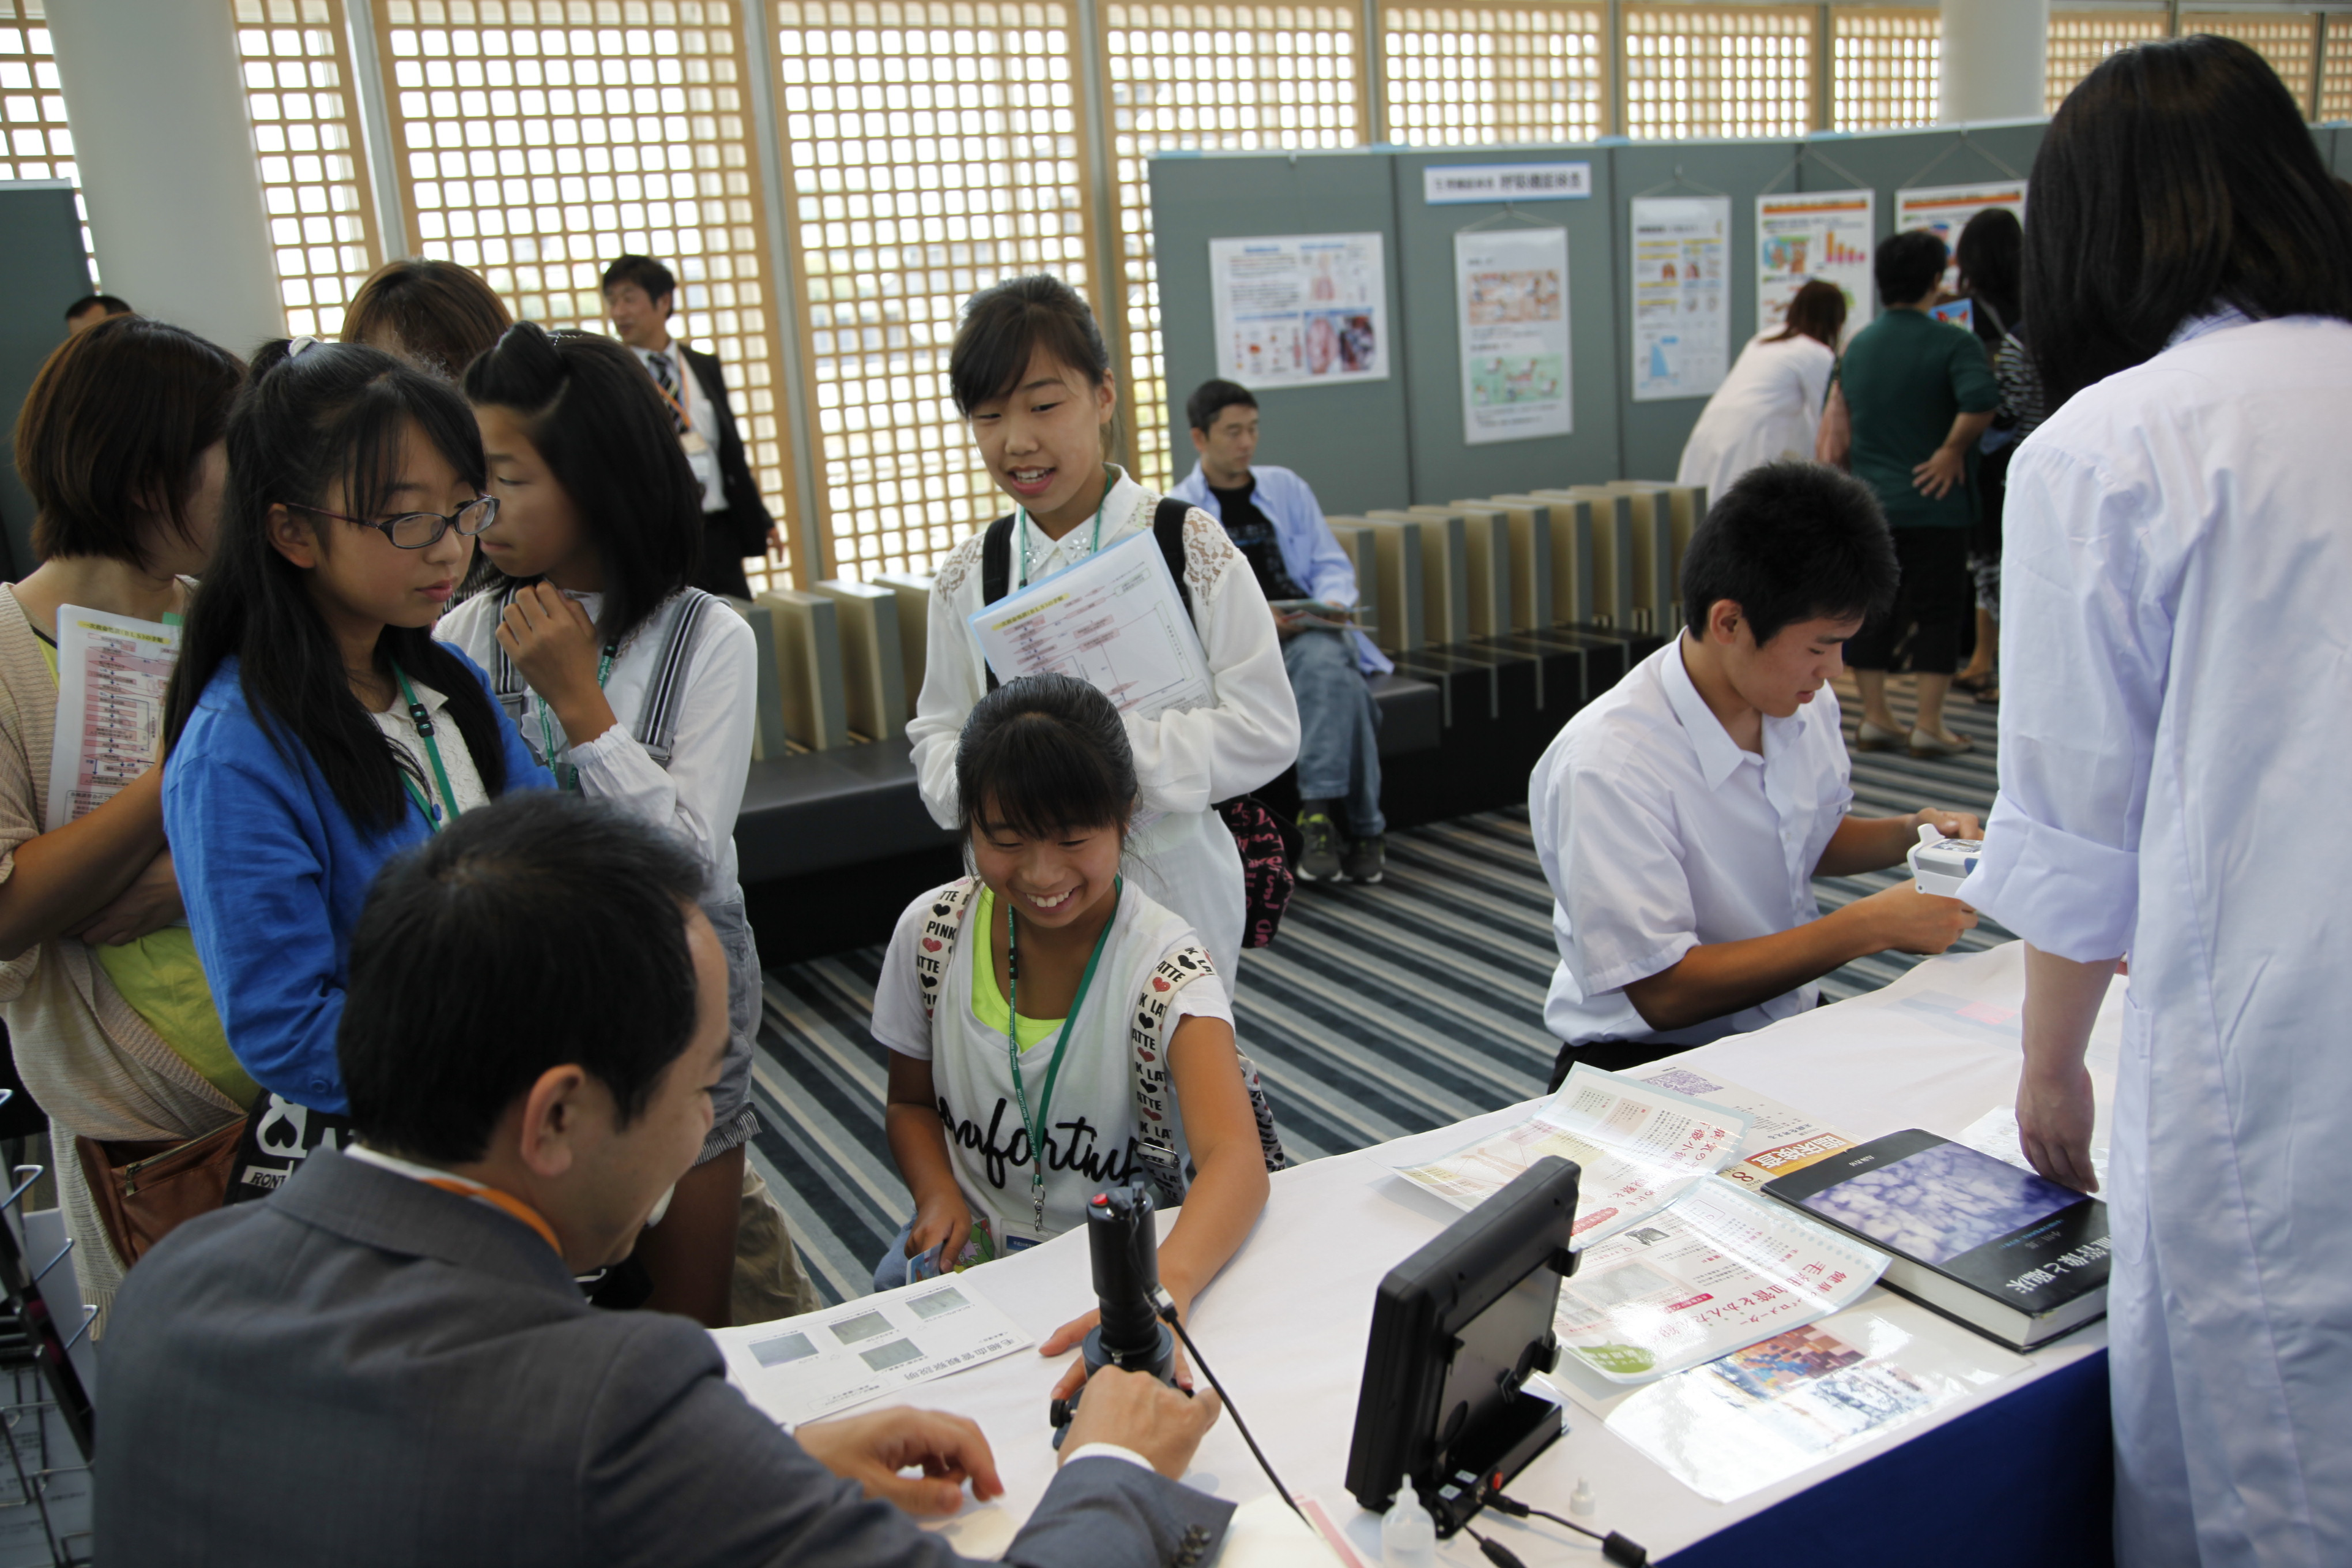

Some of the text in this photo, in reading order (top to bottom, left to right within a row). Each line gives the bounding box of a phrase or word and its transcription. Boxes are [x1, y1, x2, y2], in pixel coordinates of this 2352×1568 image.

[926, 920, 957, 940] PINK
[1017, 1088, 1029, 1118] NAVIGATOR
[1025, 1120, 1035, 1144] Science
[1751, 1135, 1847, 1167] 臨床検査
[1732, 1170, 1754, 1183] 8
[903, 1338, 1017, 1382] 毛細血管観察説明
